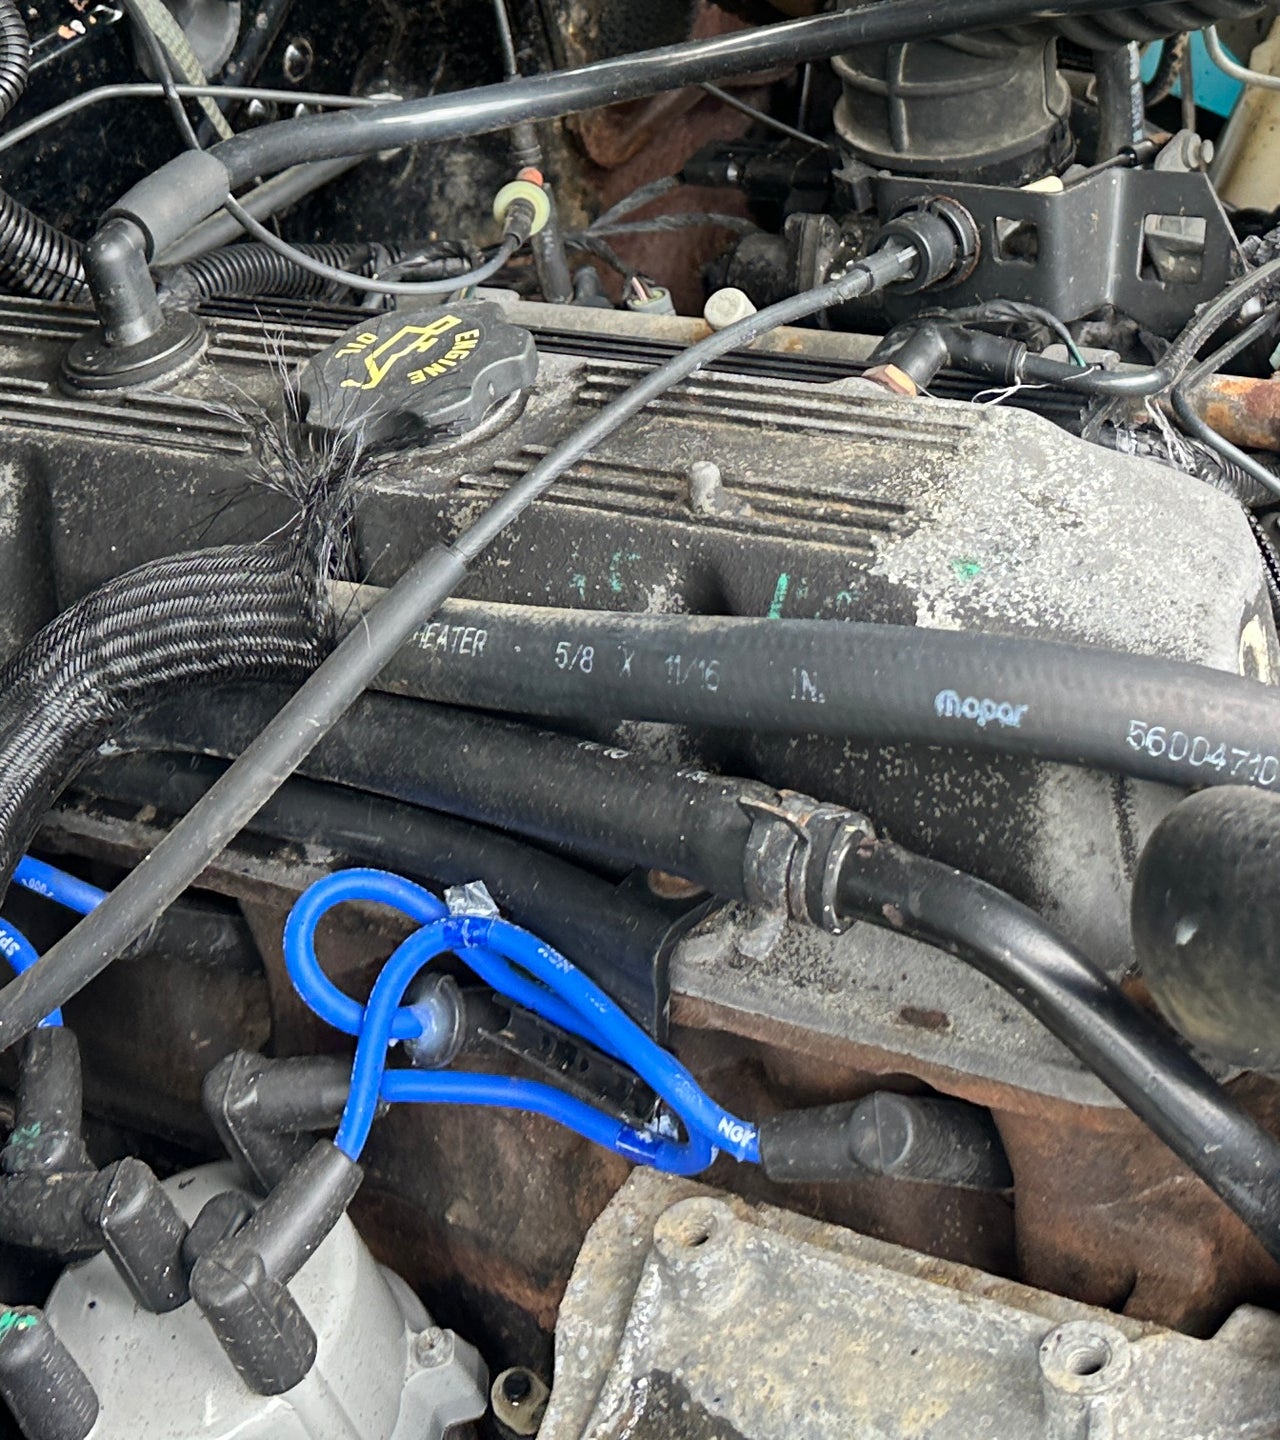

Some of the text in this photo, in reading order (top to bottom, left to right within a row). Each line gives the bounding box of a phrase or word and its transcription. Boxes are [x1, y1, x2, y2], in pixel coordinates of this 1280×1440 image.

[335, 332, 379, 359] OIL
[407, 328, 480, 385] ENGINE
[554, 641, 595, 673] 5/8
[664, 654, 719, 693] 11/16
[1126, 719, 1280, 787] 56004710
